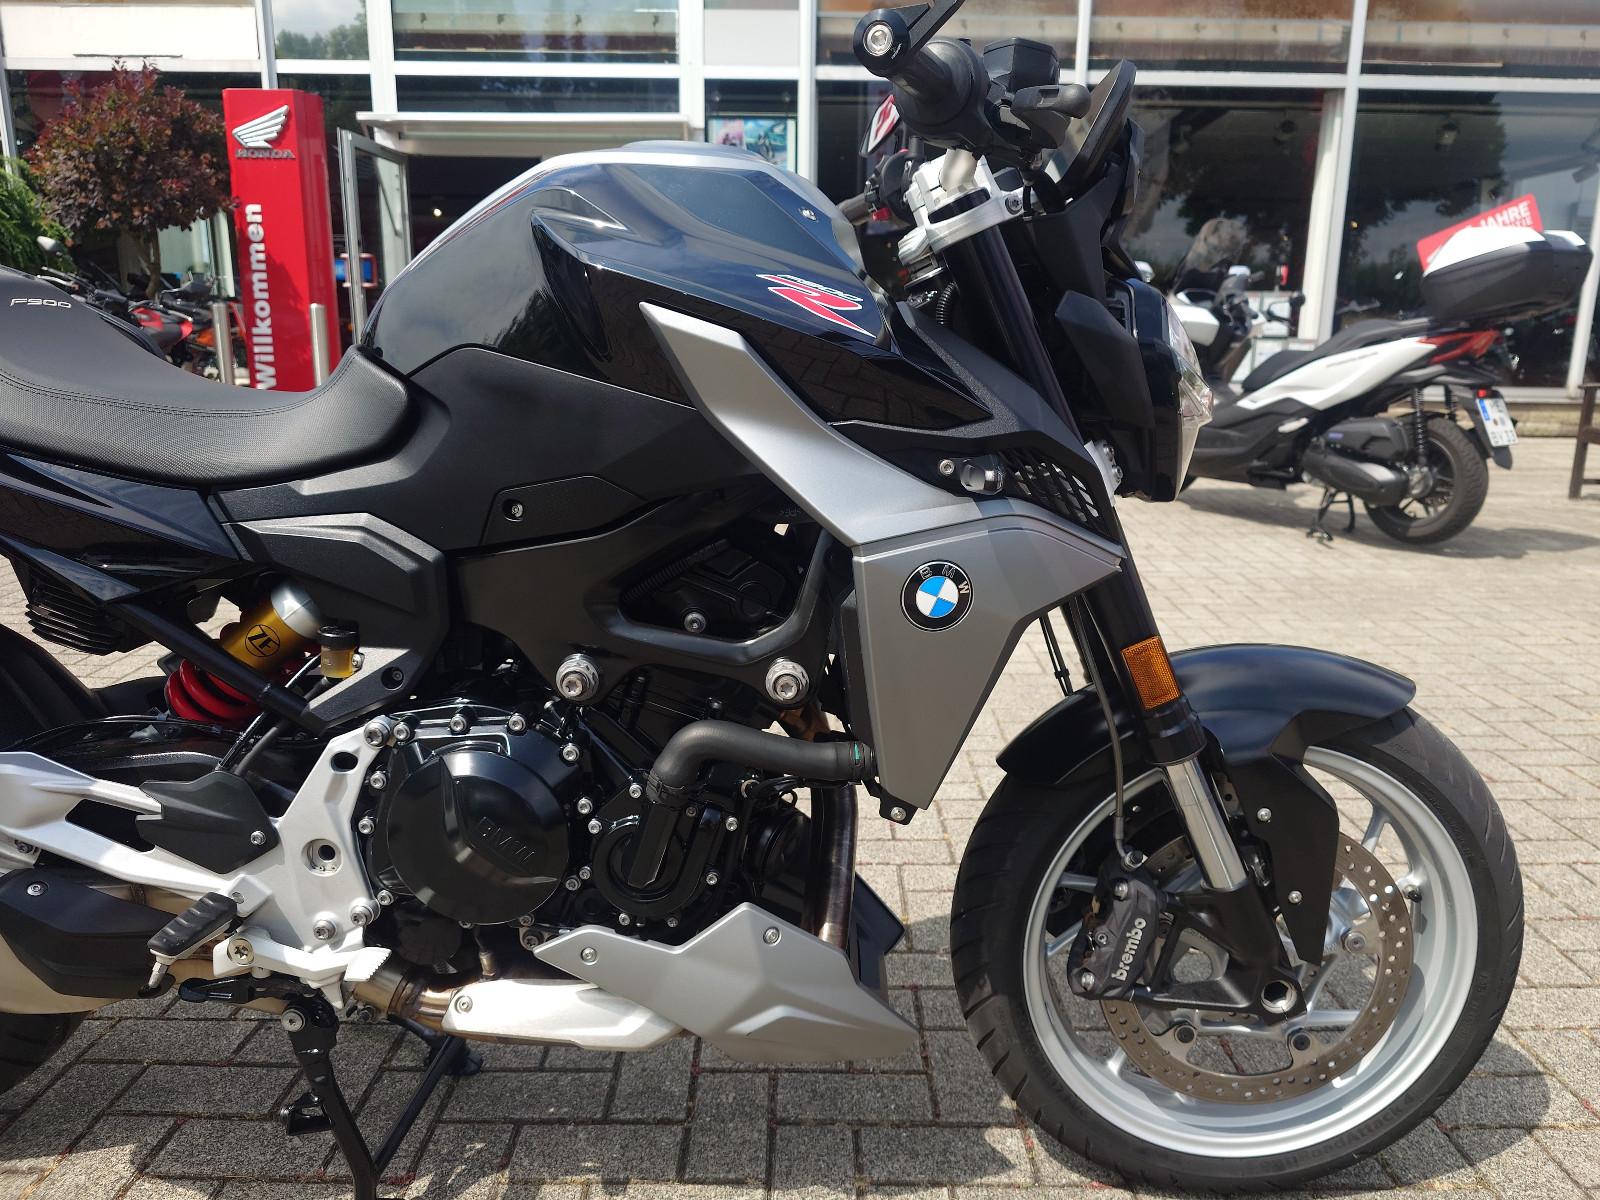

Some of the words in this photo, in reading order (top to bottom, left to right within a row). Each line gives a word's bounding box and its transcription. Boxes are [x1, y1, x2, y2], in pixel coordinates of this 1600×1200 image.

[236, 148, 296, 158] HONDA
[10, 298, 72, 309] F900
[245, 203, 277, 390] Willkommen
[919, 564, 970, 594] BMW
[246, 624, 280, 657] ZF
[1111, 917, 1147, 981] brembo
